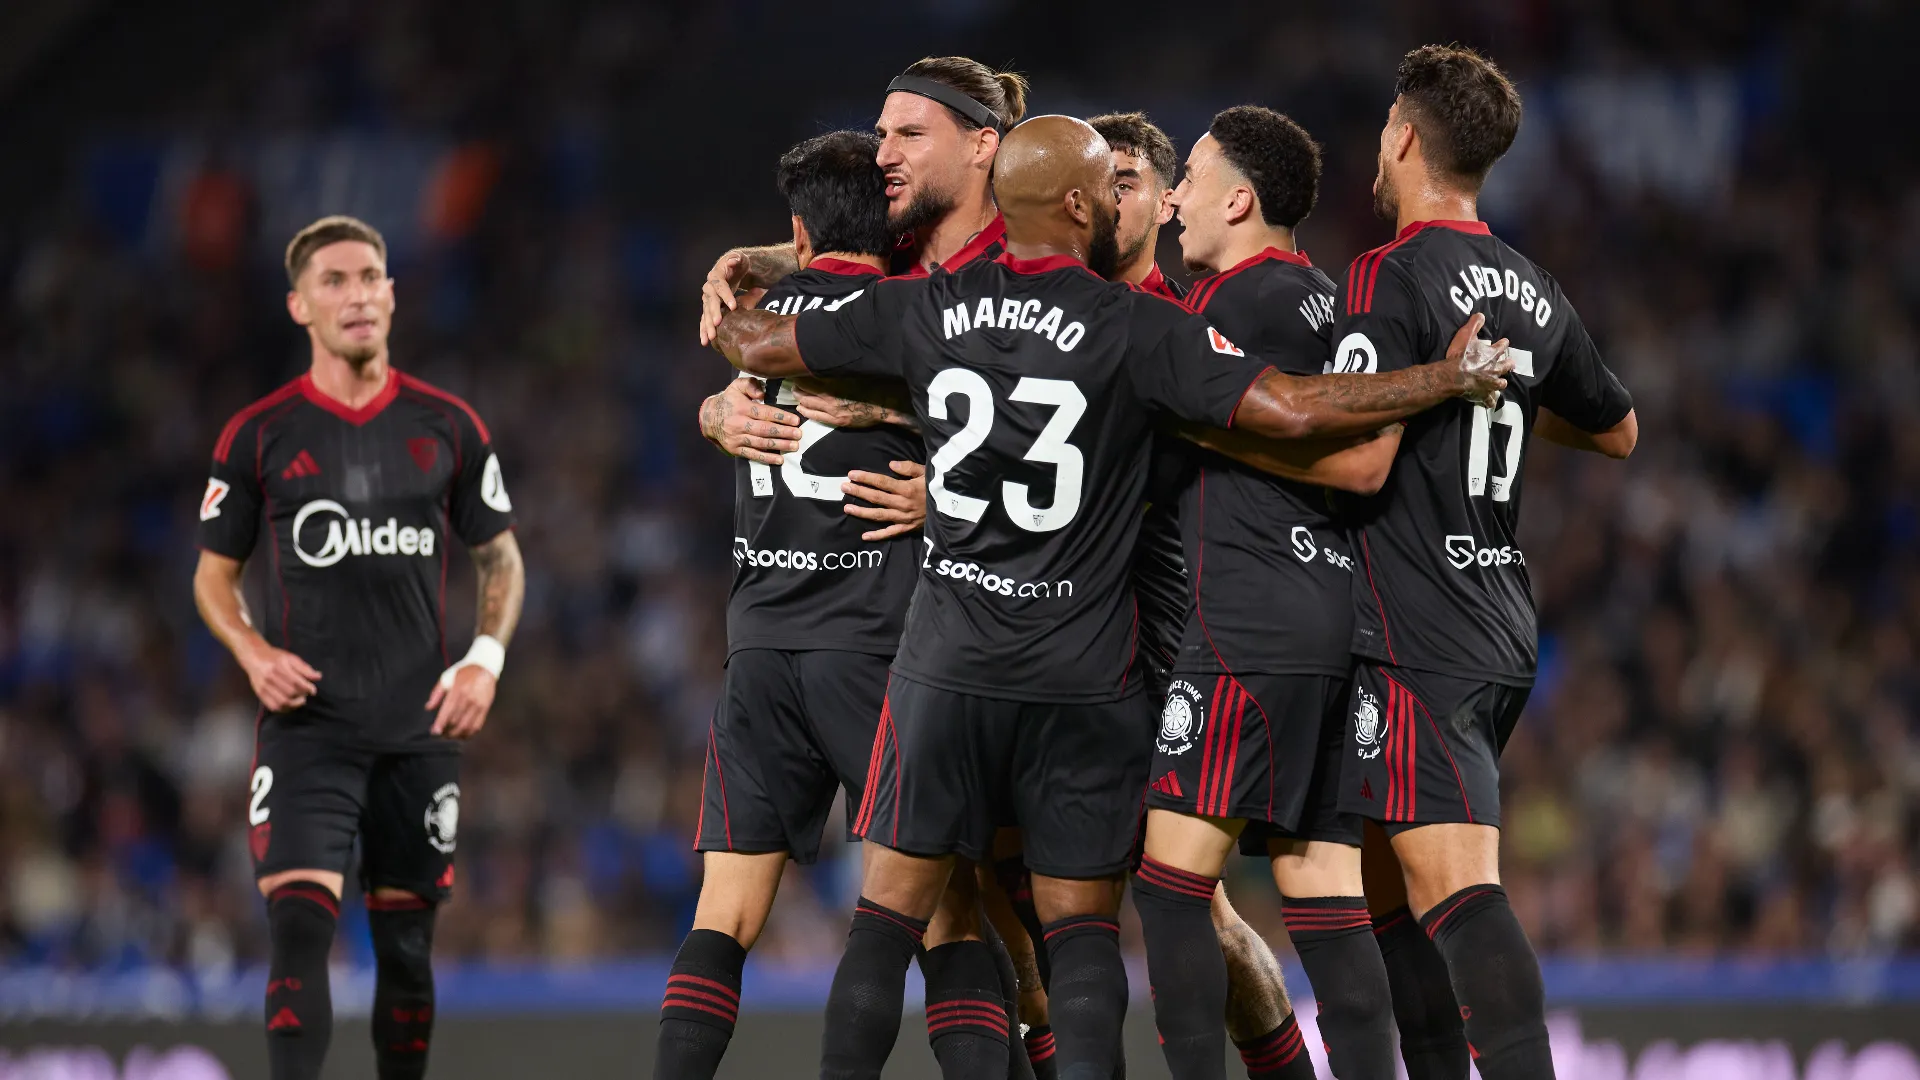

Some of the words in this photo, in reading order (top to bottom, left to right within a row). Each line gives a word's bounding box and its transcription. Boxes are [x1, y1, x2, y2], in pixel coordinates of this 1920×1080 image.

[943, 297, 1086, 352] MARCAO
[926, 367, 1088, 532] 23
[312, 516, 435, 559] Midea
[746, 549, 883, 571] socios.com
[935, 559, 1073, 598] socios.com
[1183, 681, 1203, 702] TIME
[249, 765, 274, 827] 2
